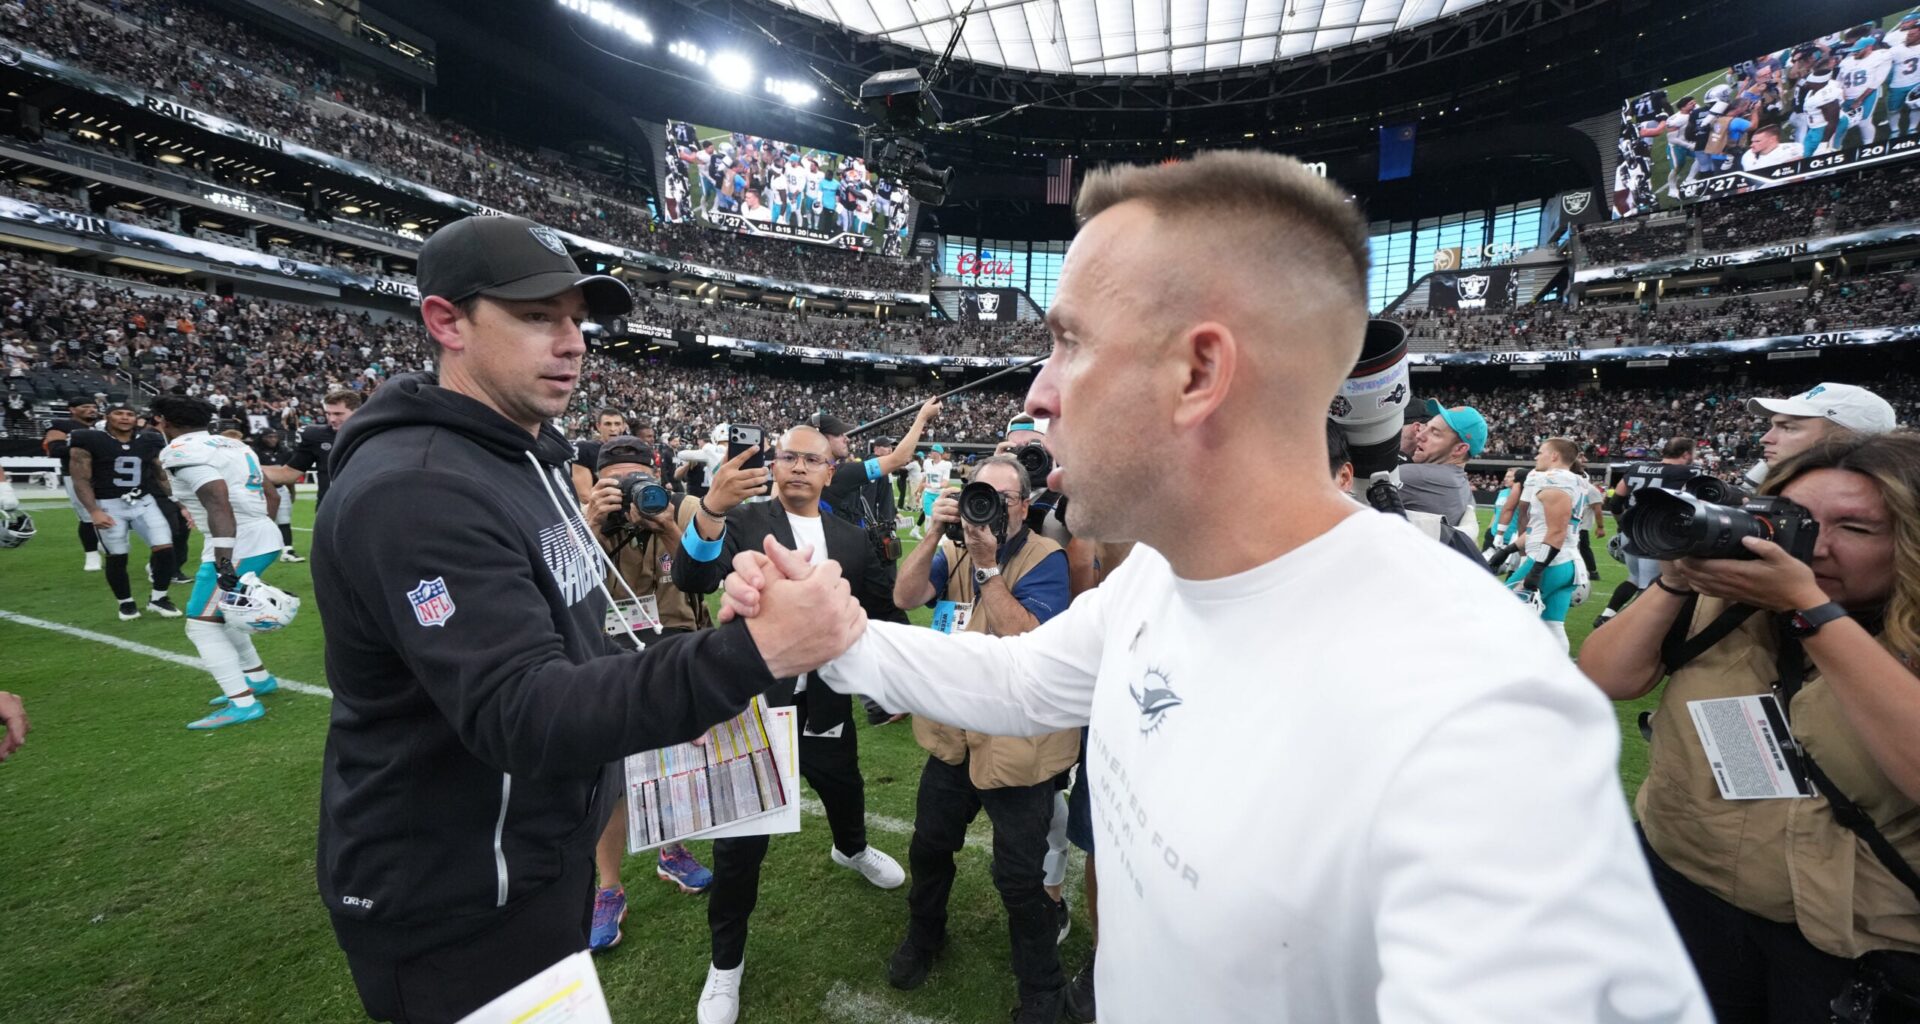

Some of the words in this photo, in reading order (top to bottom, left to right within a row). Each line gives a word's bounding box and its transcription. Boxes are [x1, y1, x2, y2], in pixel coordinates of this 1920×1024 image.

[1714, 177, 1735, 192] 27
[1809, 154, 1844, 169] 0:15
[1861, 145, 1884, 158] 20
[957, 253, 1013, 275] Coors
[113, 456, 142, 487] 9
[418, 596, 450, 621] NFL
[1152, 830, 1199, 891] FOR
